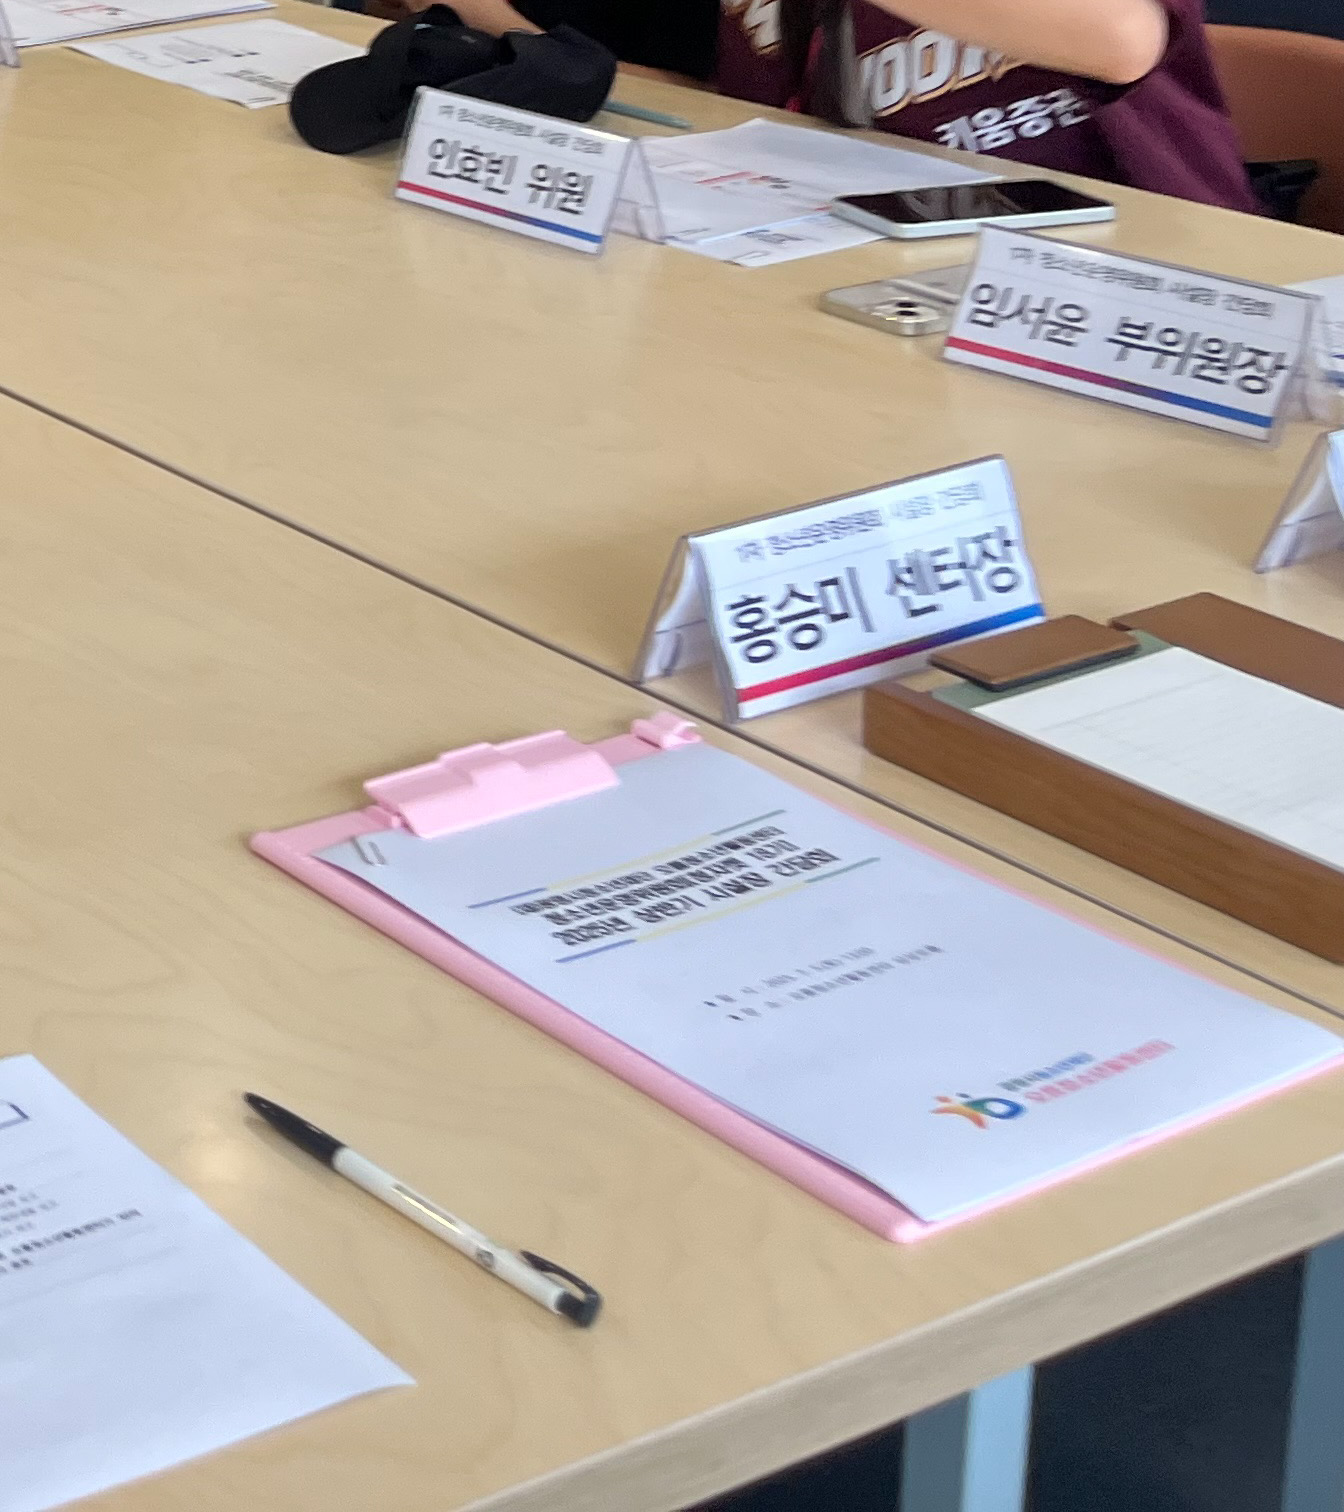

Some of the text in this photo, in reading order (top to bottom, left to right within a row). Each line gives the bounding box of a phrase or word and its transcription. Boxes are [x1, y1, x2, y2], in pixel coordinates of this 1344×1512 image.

[525, 163, 594, 216] 위원
[966, 282, 1290, 396] 임서윤 부위원장
[725, 524, 1022, 665] 홍승미 센터장
